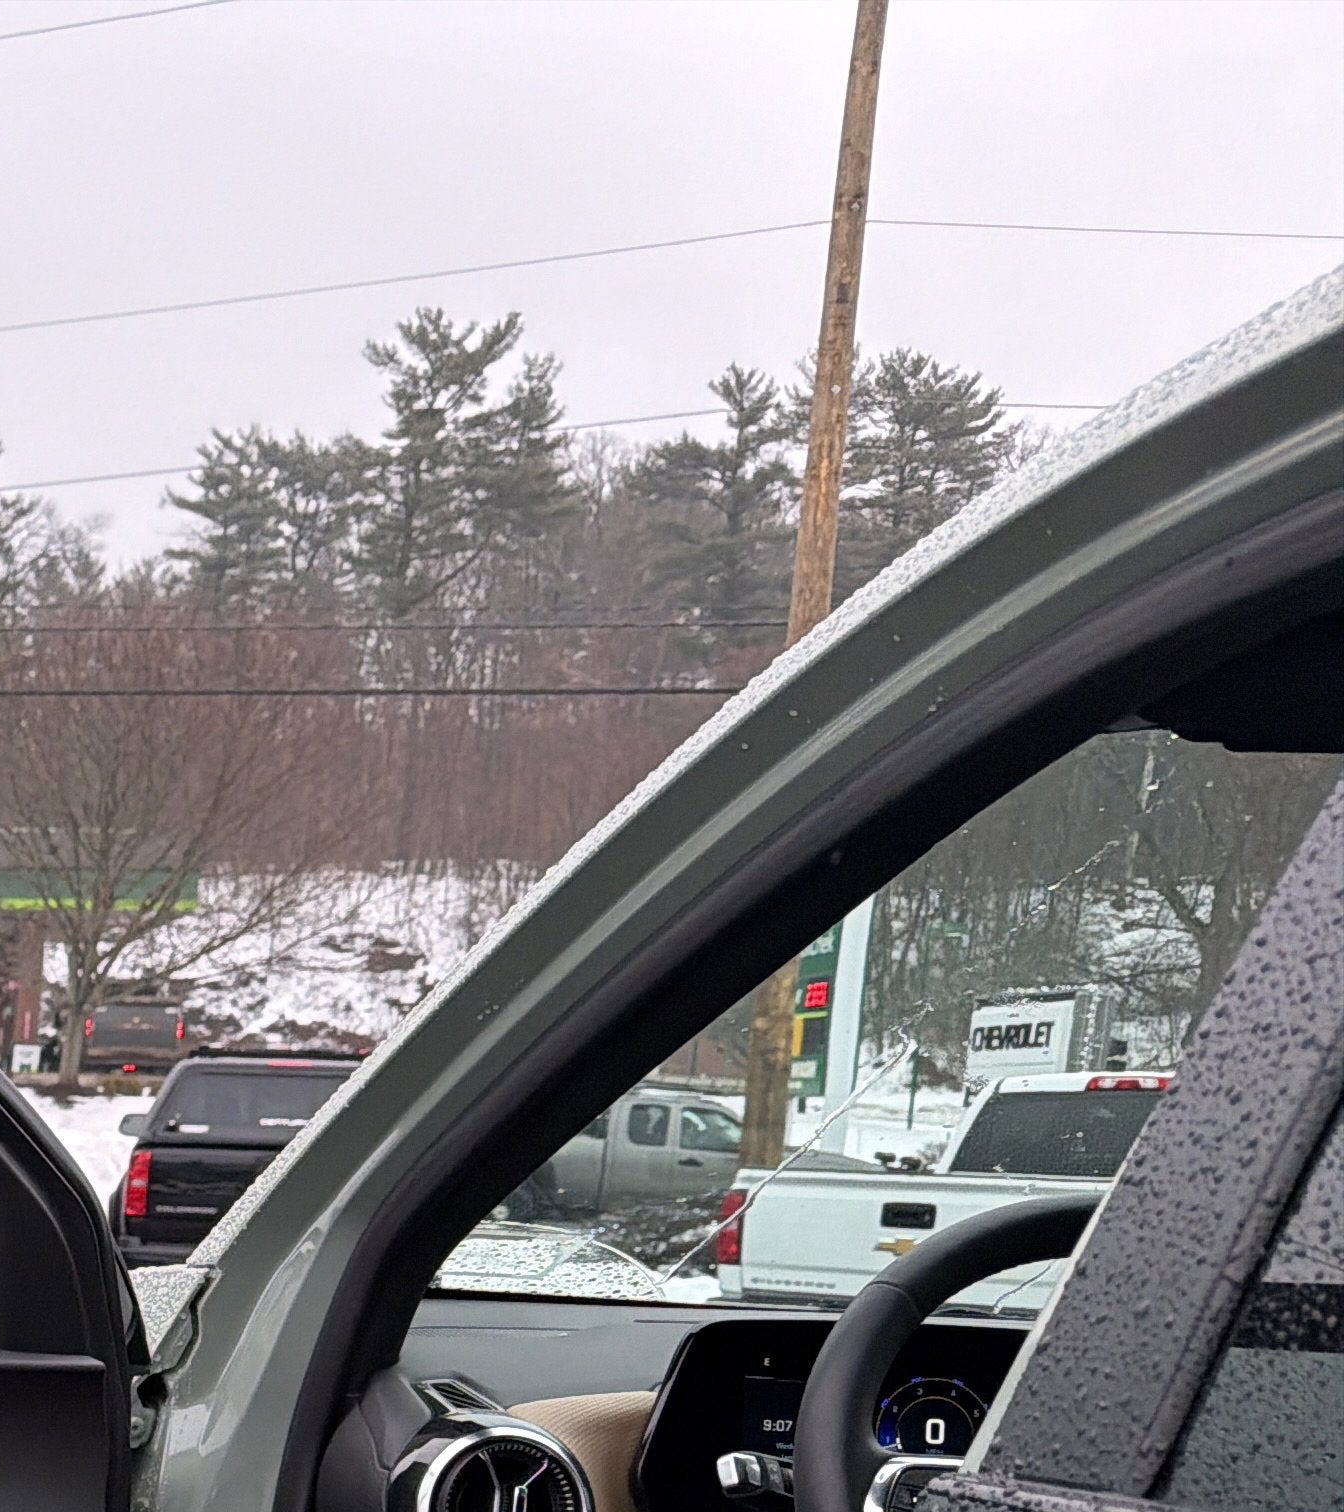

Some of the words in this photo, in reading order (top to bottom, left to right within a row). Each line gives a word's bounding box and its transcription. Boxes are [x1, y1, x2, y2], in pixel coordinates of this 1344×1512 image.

[763, 1357, 771, 1366] E
[762, 1419, 793, 1432] 9:07
[925, 1418, 946, 1445] 0
